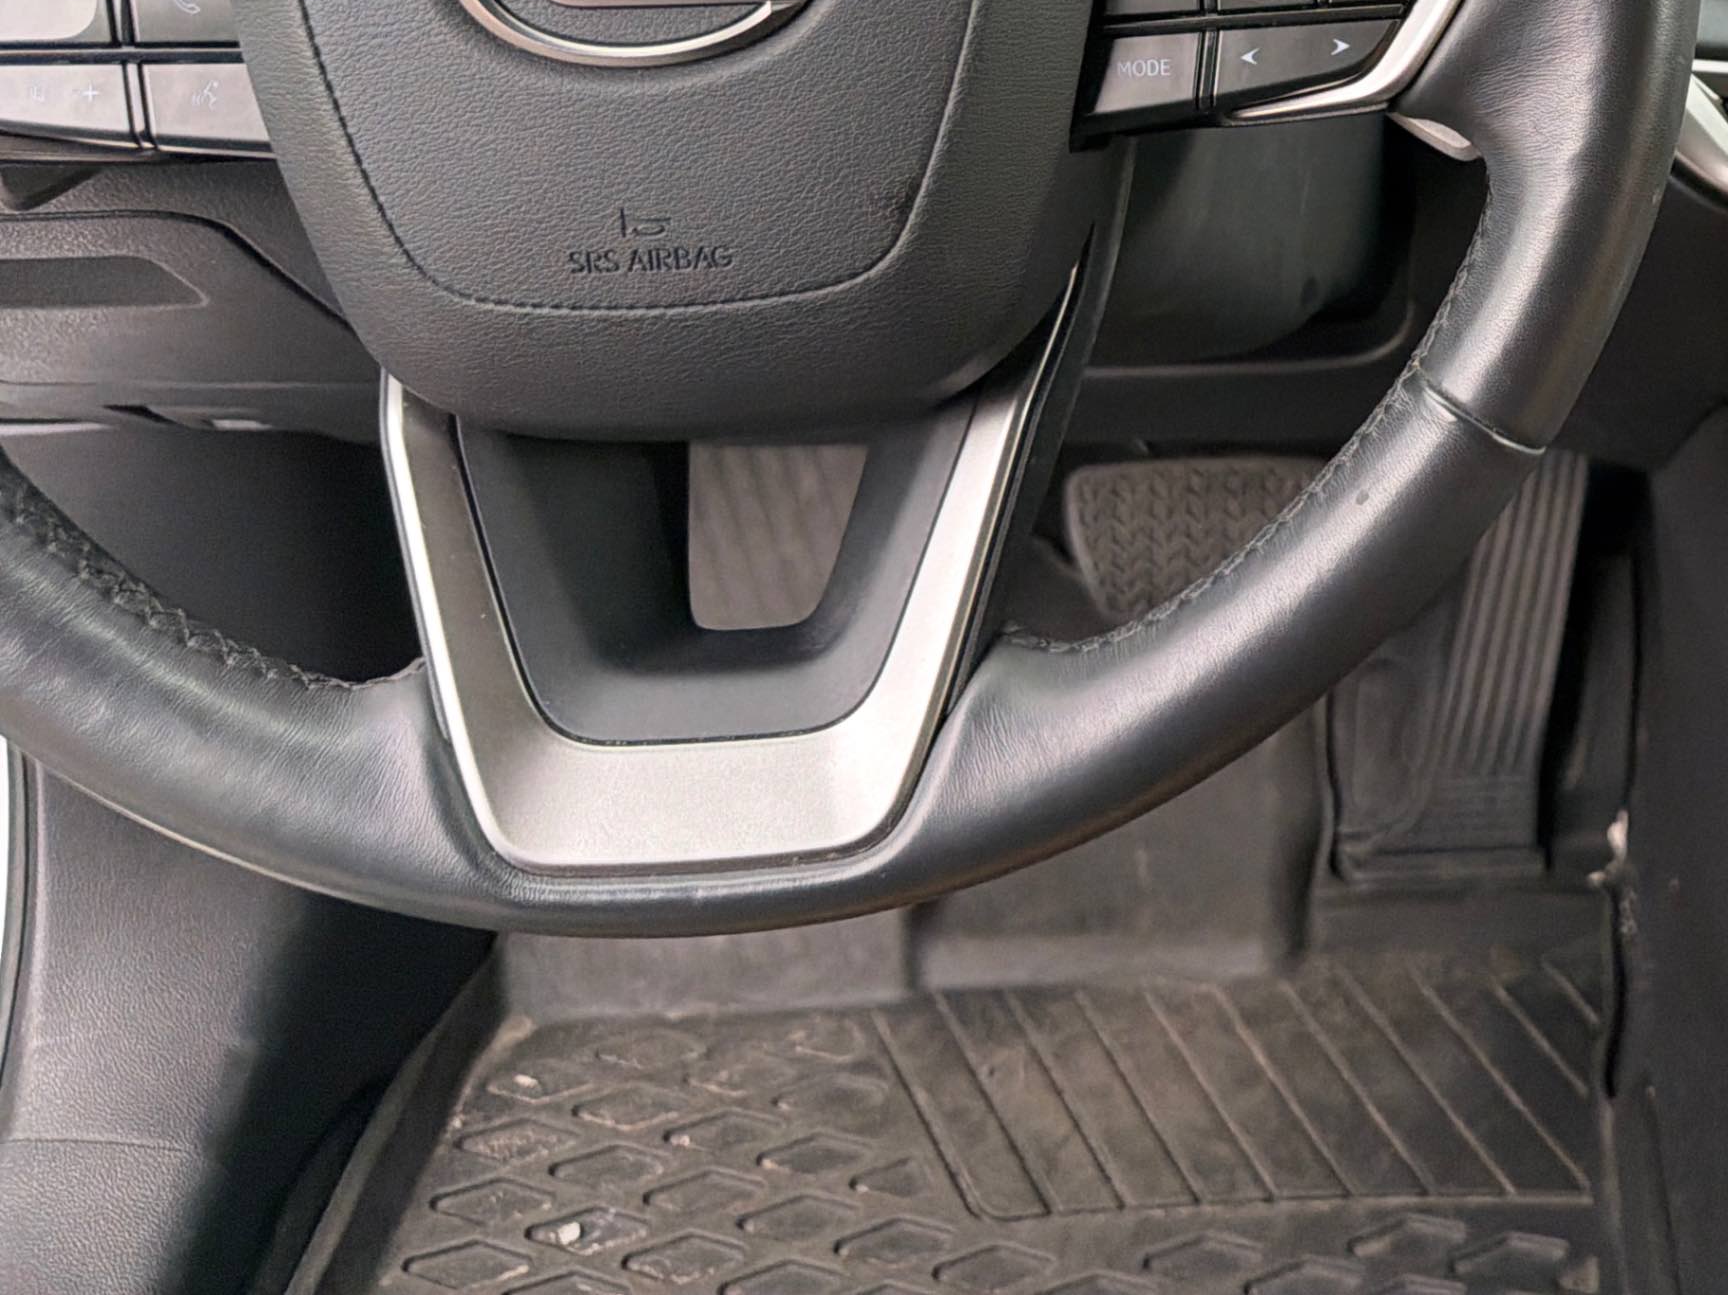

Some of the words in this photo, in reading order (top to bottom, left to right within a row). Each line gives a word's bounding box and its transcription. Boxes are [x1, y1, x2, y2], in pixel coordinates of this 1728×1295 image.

[1117, 59, 1171, 78] MODE
[569, 250, 620, 274] SRS
[627, 245, 733, 273] AIRBAG
